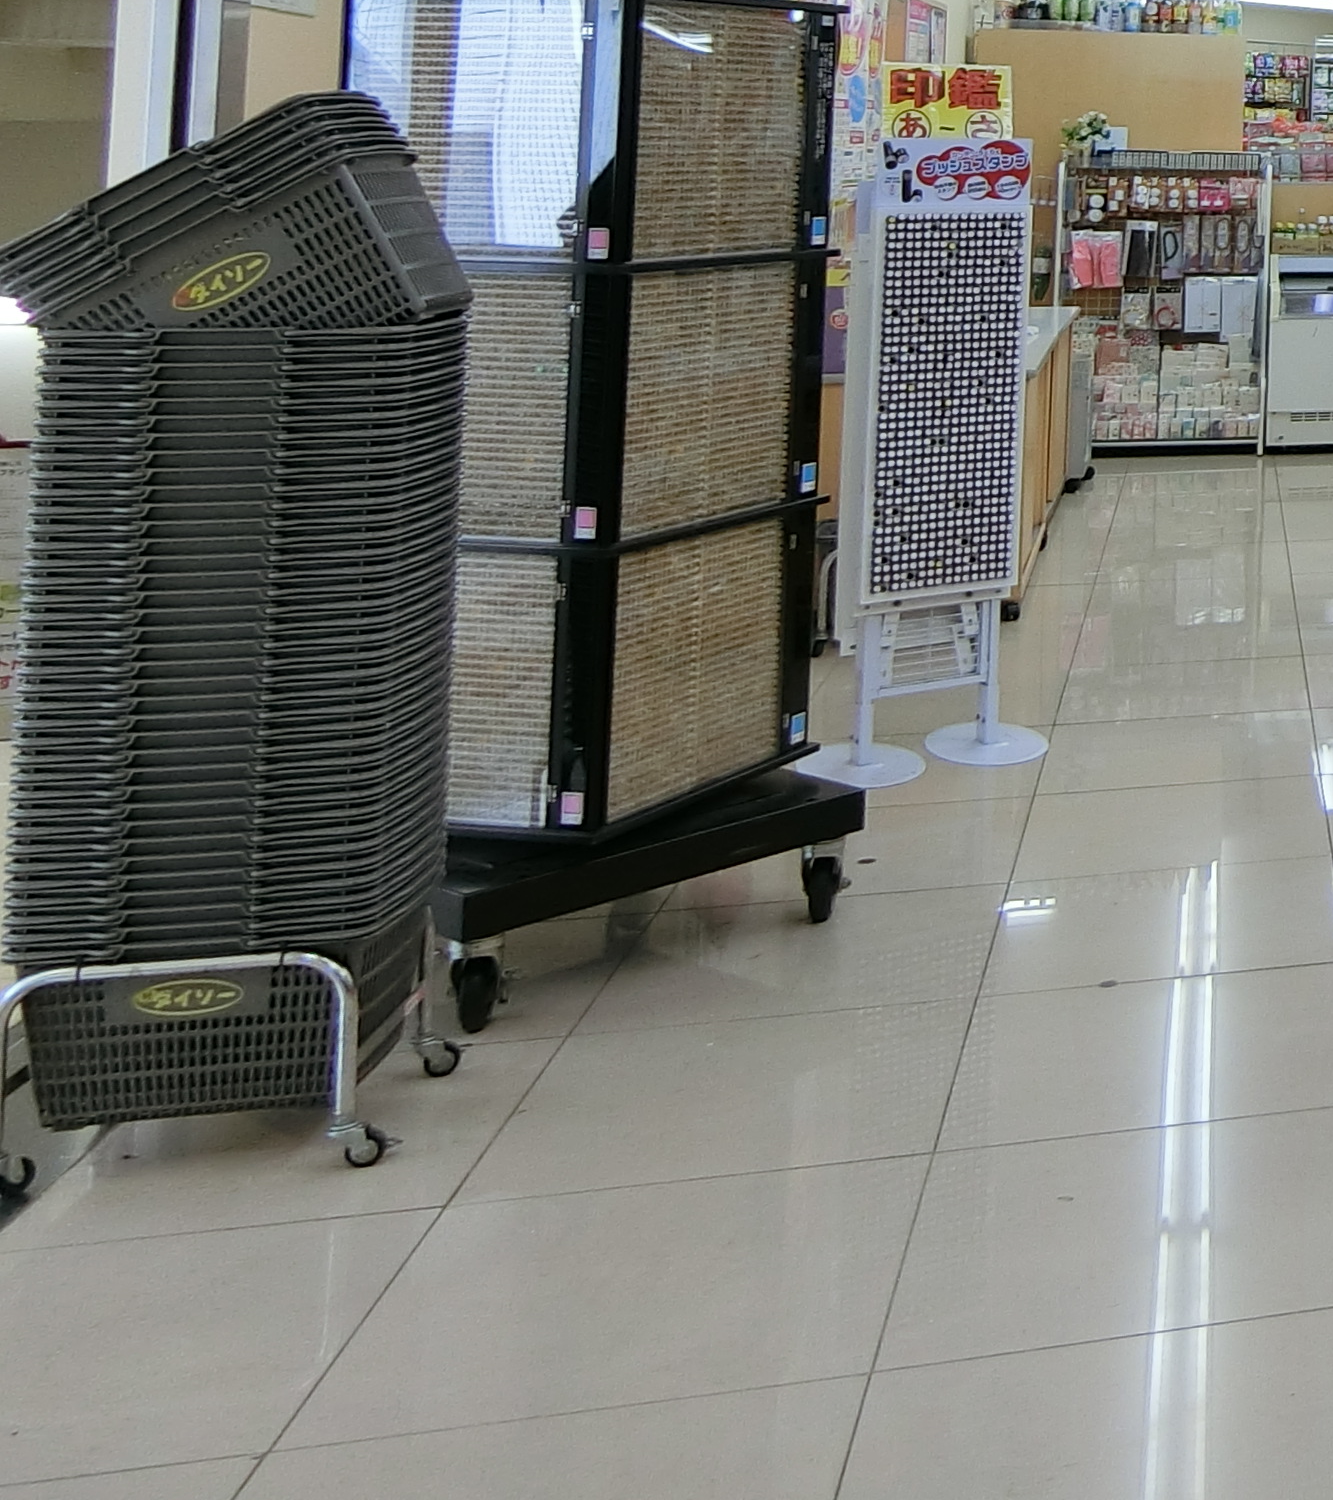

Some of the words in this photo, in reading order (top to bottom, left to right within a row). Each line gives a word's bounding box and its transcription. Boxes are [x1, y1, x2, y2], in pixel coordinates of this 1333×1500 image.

[889, 67, 1002, 109] 印鑑
[924, 152, 1029, 176] プッシュスタンプ
